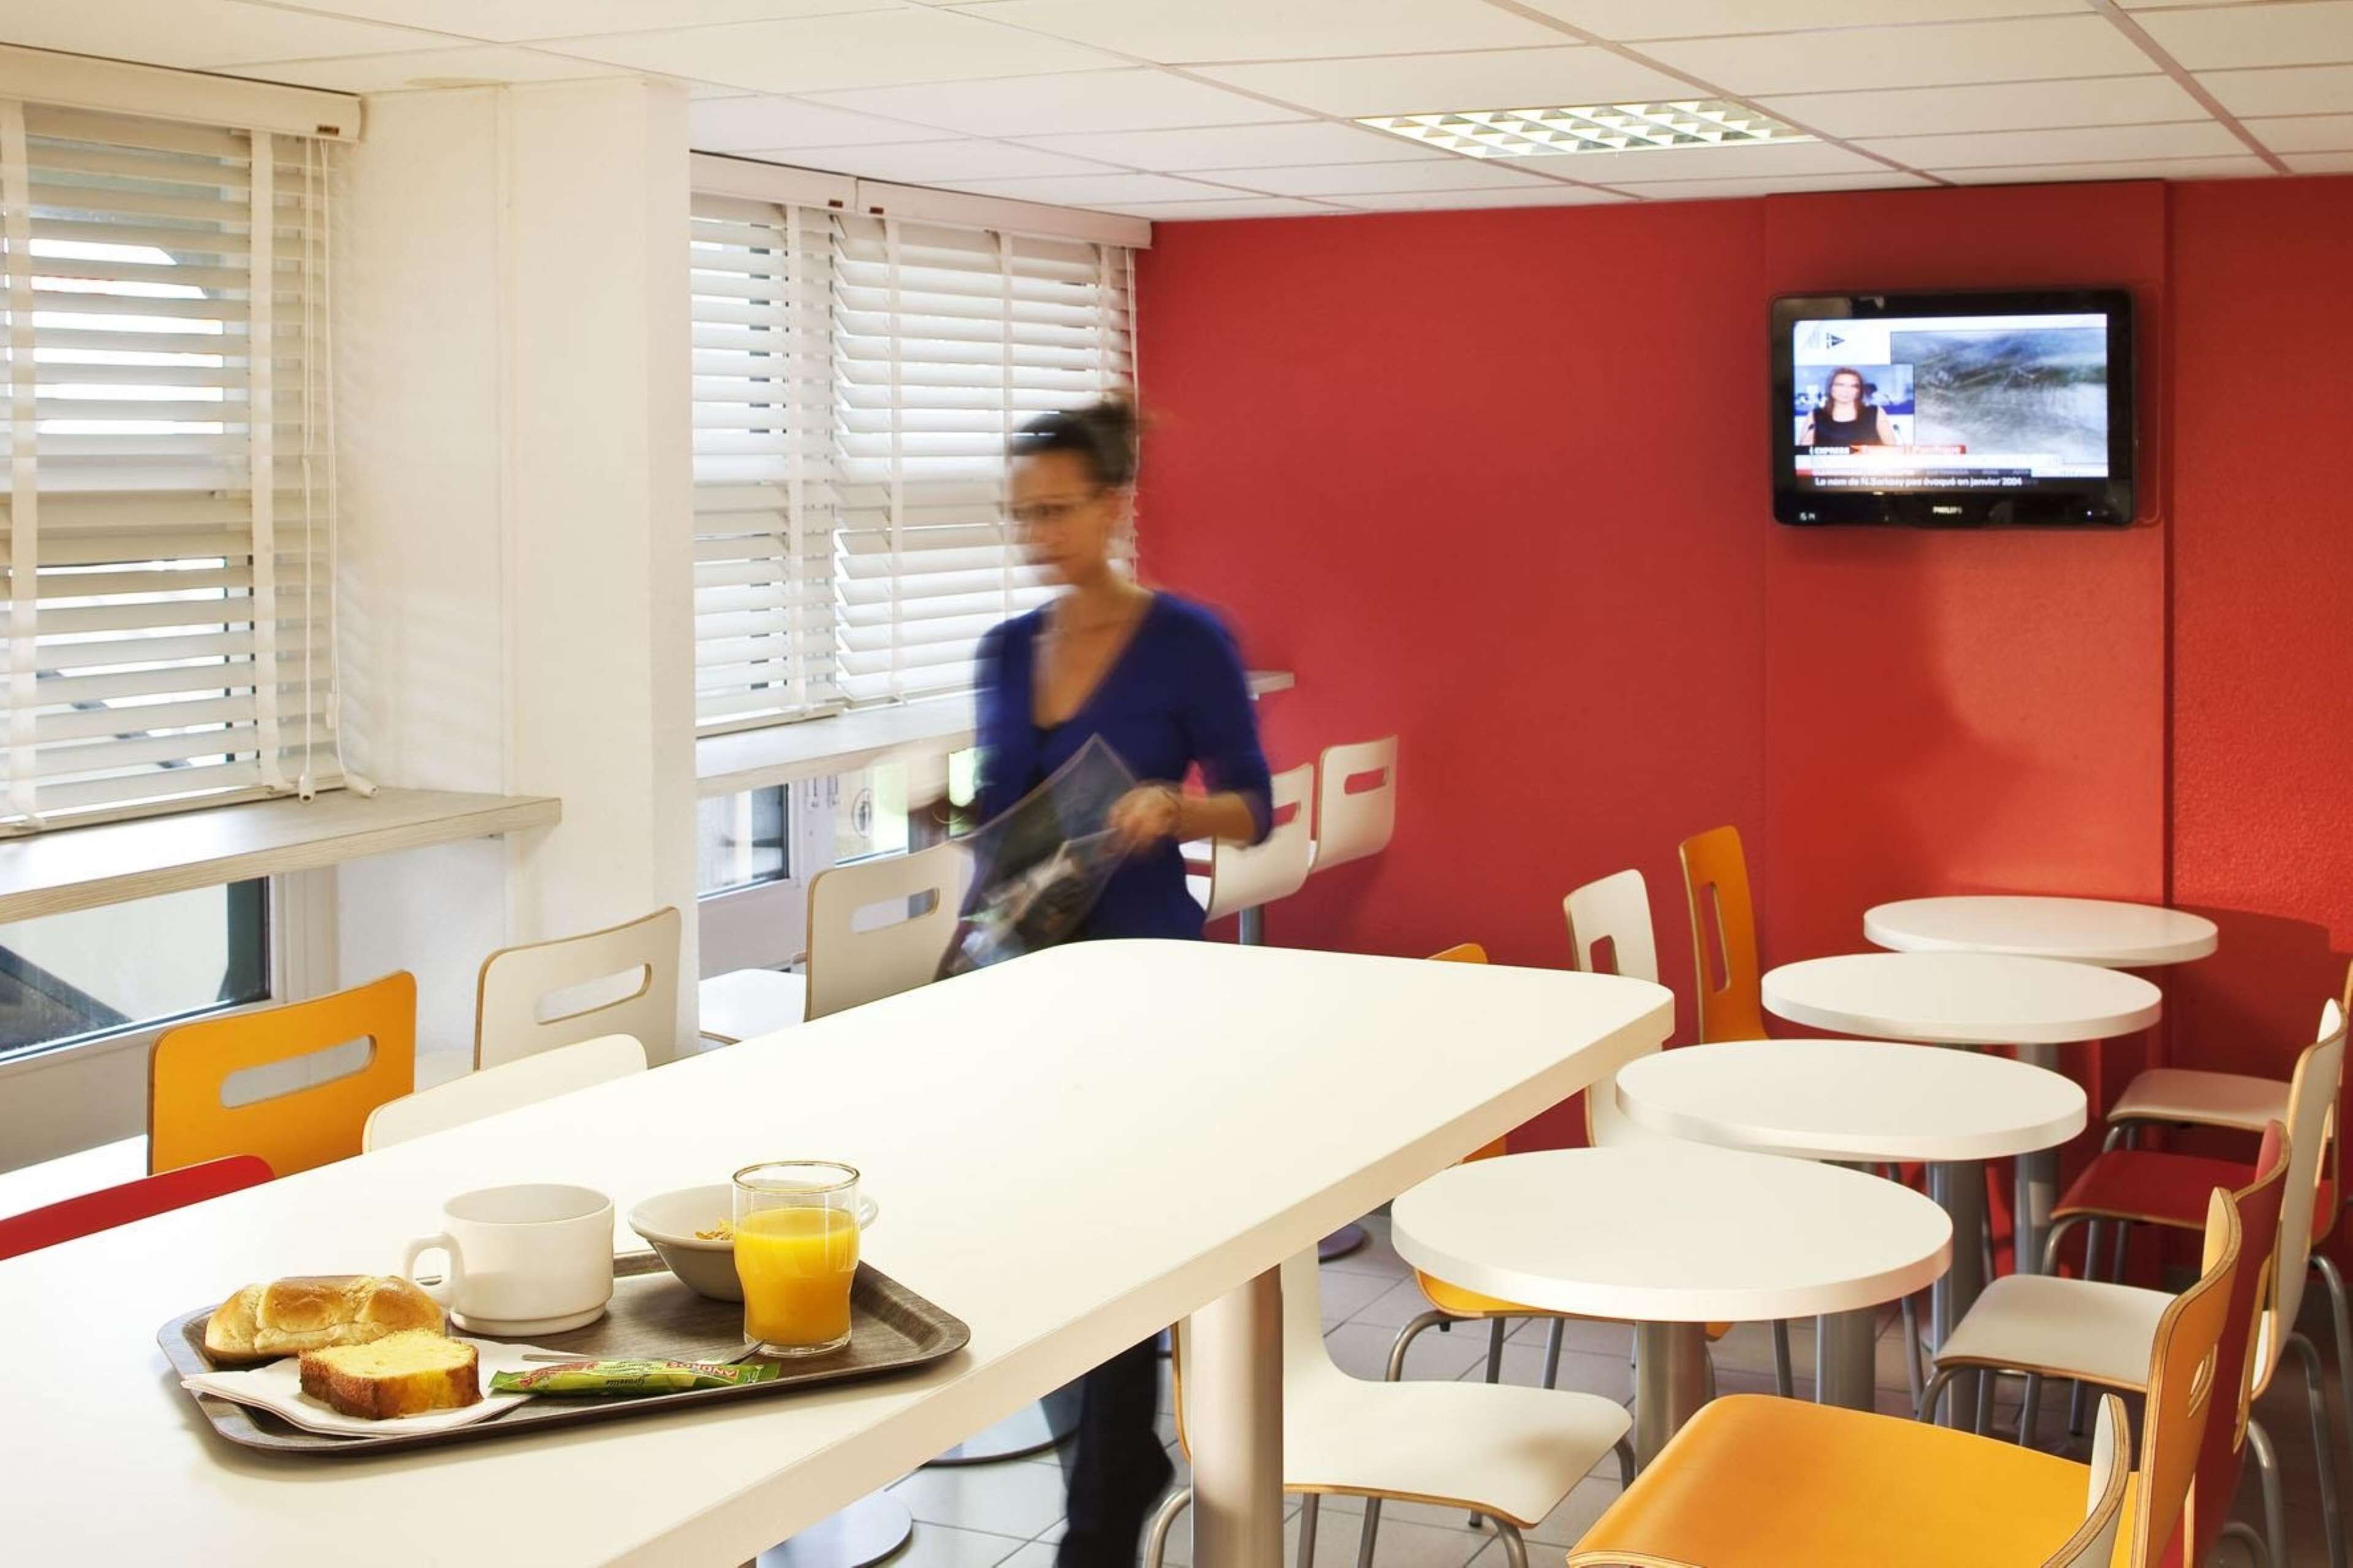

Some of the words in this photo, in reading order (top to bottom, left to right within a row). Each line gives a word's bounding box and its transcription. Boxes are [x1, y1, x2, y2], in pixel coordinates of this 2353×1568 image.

[1815, 477, 1826, 486] Le
[1847, 477, 1858, 486] de
[1923, 477, 1956, 488] évoqué
[1970, 477, 2001, 488] janvier
